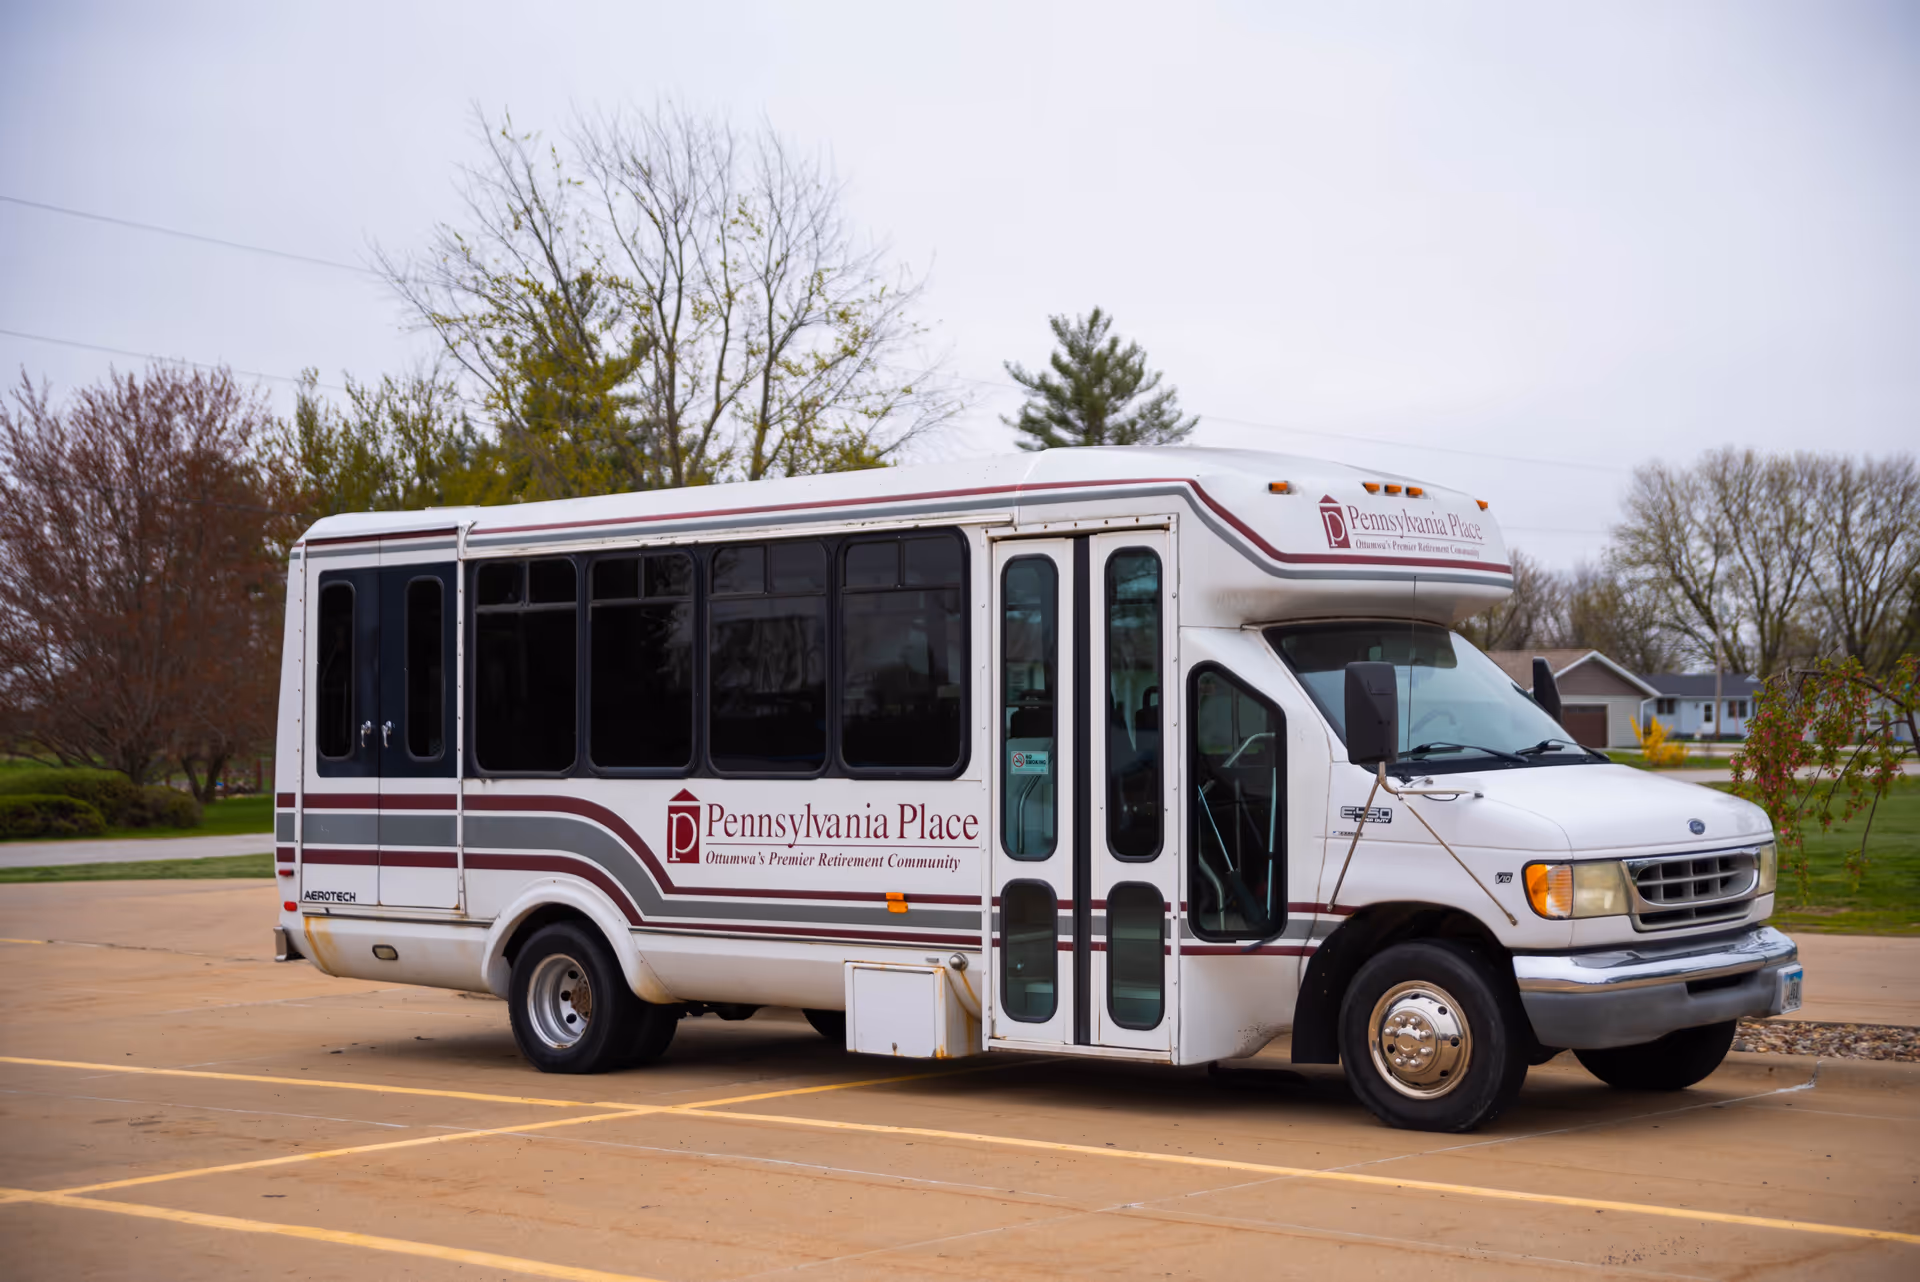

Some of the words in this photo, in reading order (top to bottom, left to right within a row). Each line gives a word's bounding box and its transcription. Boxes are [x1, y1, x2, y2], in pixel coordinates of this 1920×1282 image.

[1346, 505, 1448, 538] Pennsylvania
[1447, 513, 1482, 540] Place
[1355, 539, 1391, 550] Ottumwa's
[1392, 541, 1417, 552] Premier
[1419, 542, 1450, 554] Retirement
[706, 803, 889, 848] Pennsylvania
[897, 803, 979, 840] Place
[706, 850, 765, 865] Ottumwa's
[768, 851, 815, 867] Premier
[818, 852, 884, 868] Retirement
[887, 853, 961, 873] Community
[304, 890, 356, 902] AEROTECH
